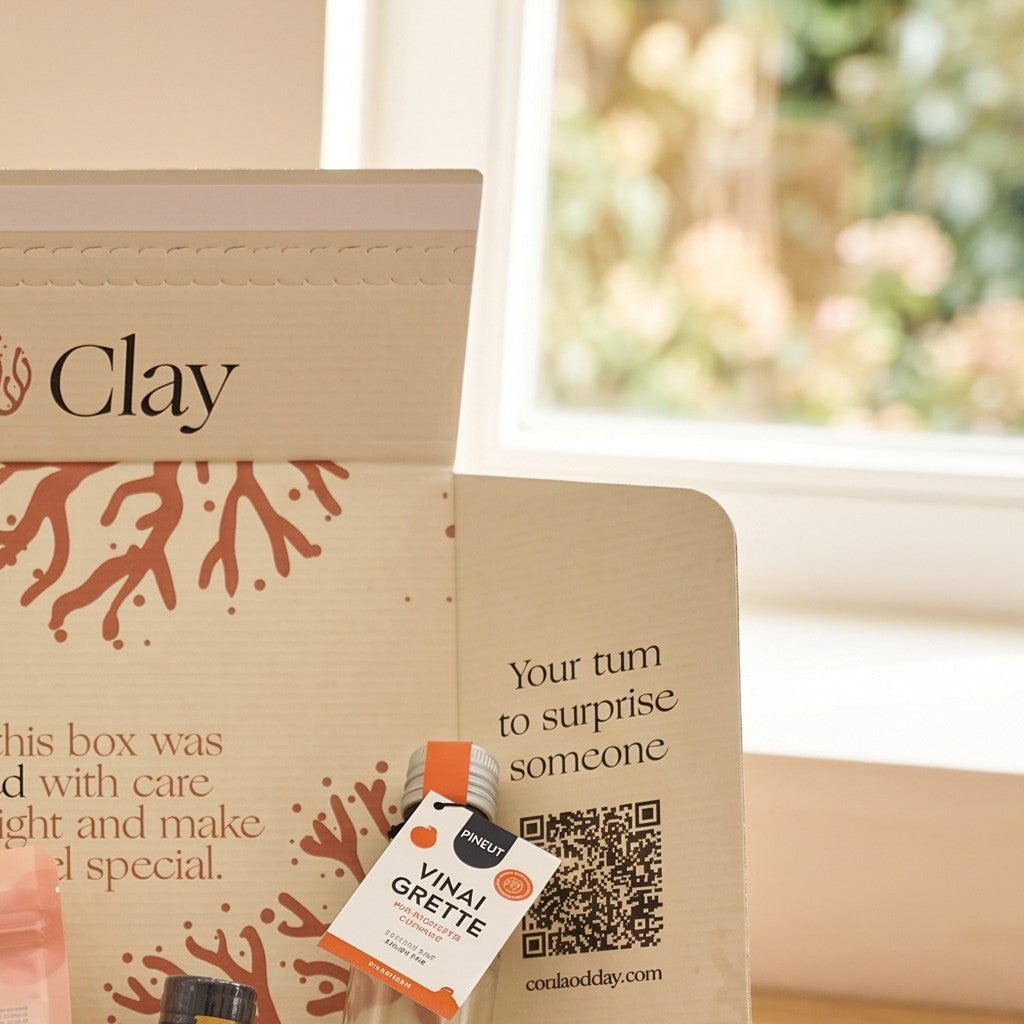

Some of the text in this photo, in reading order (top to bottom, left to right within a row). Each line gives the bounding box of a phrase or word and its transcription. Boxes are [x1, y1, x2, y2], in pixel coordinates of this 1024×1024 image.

[49, 333, 240, 434] Clay
[508, 657, 581, 690] Your
[498, 688, 679, 738] to surprise
[68, 722, 138, 758] box
[150, 730, 224, 758] was
[509, 738, 670, 782] someone
[39, 764, 119, 798] with
[132, 769, 214, 798] care
[76, 805, 145, 841] and
[160, 805, 266, 841] make
[460, 829, 506, 857] PINEUT
[86, 845, 224, 892] special.
[420, 862, 488, 911] VINAI
[391, 876, 487, 938] GRETTE
